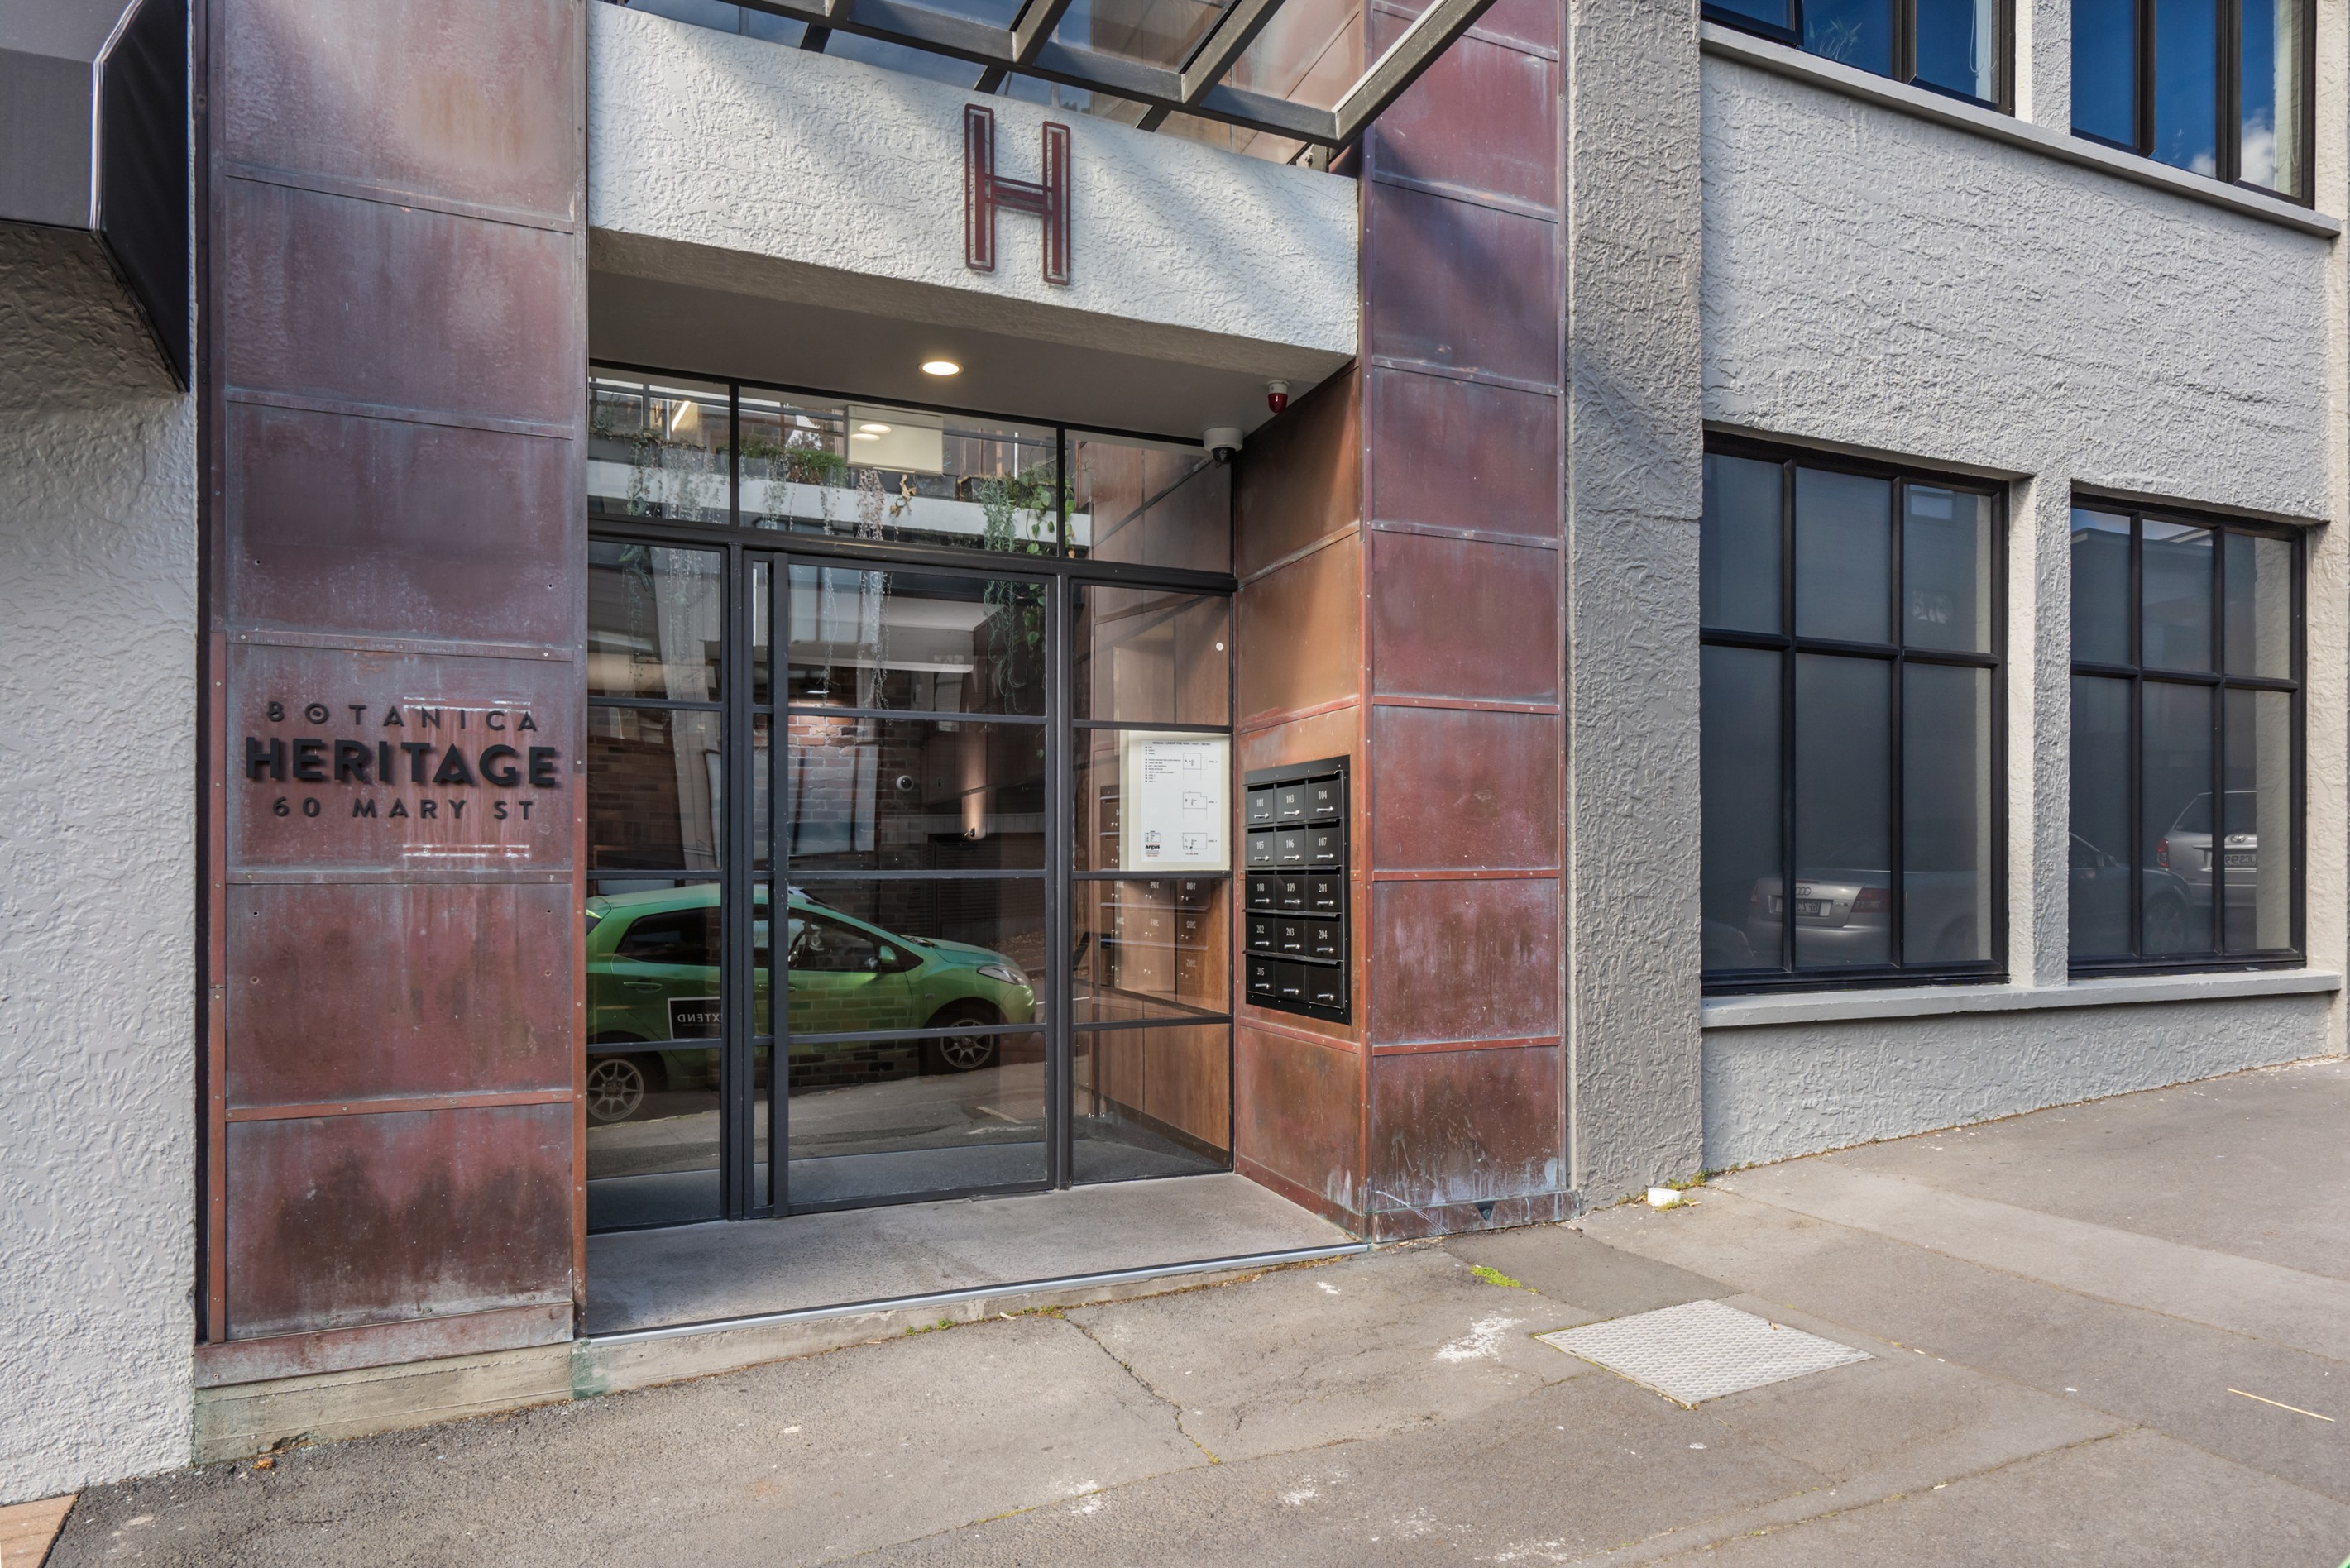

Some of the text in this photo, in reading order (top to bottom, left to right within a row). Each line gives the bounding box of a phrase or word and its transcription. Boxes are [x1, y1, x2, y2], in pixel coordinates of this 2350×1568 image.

[964, 103, 1070, 285] H
[267, 701, 537, 731] BOTANICA
[246, 737, 555, 786] HERITAGE
[1285, 795, 1295, 804] 103
[1318, 791, 1328, 800] 104
[273, 796, 533, 820] 60 MARY ST
[1256, 841, 1265, 849] 105
[1285, 839, 1295, 849] 106
[1318, 838, 1328, 847] 107
[1256, 883, 1265, 892] 108
[1286, 883, 1295, 892] 109
[1319, 884, 1328, 893] 201
[1256, 925, 1265, 934] 202
[1285, 928, 1295, 937] 203
[1318, 930, 1328, 939] 204
[1256, 968, 1265, 976] 205
